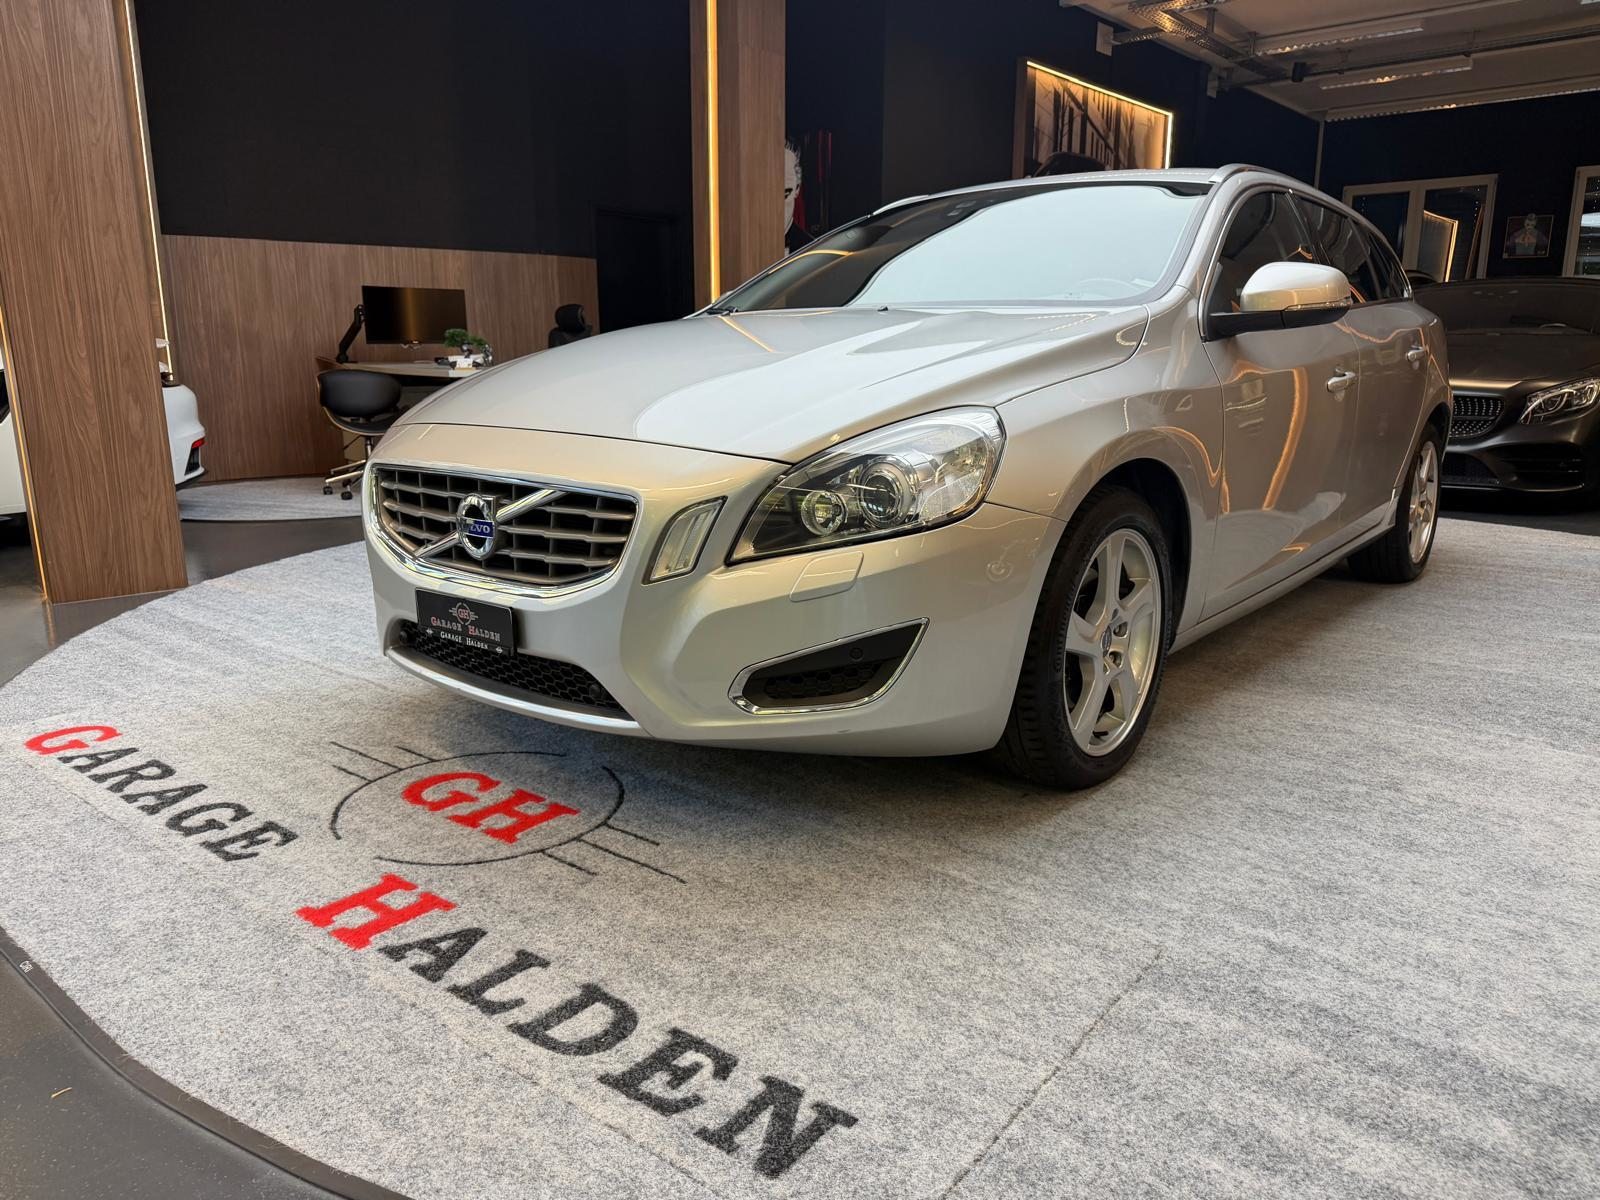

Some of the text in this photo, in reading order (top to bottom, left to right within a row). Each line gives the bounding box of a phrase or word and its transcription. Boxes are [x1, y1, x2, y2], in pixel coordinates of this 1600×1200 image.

[465, 523, 491, 534] LVO
[457, 608, 470, 620] GH
[431, 616, 501, 642] GARAGE HALDEN
[440, 631, 489, 650] GARAGE HALDEN
[25, 725, 298, 861] GARAGE
[400, 772, 580, 843] GH
[295, 873, 859, 1178] HALDEN
